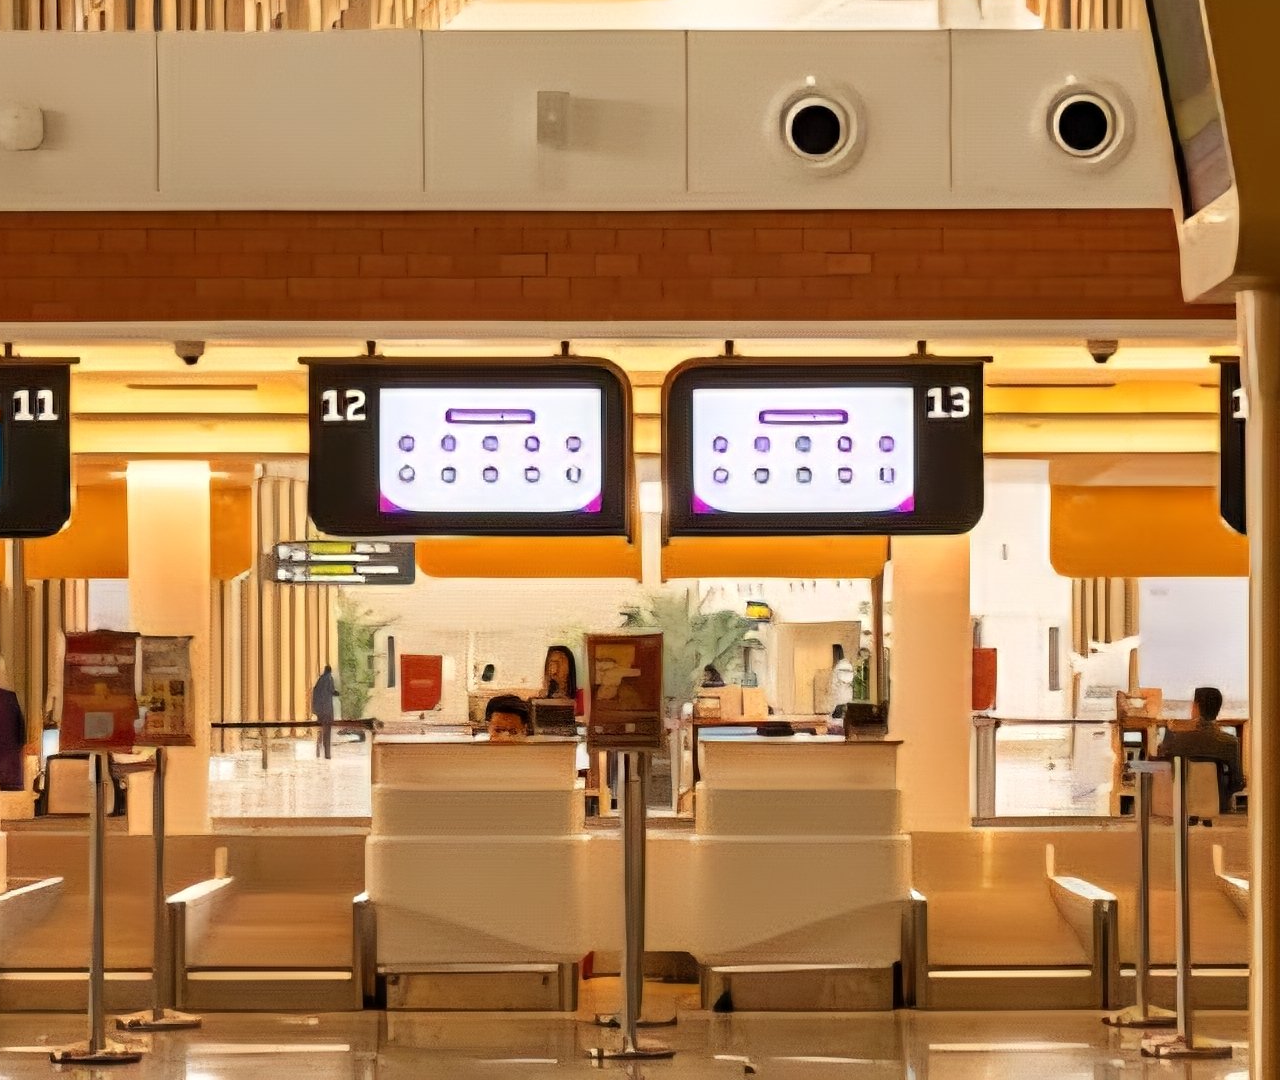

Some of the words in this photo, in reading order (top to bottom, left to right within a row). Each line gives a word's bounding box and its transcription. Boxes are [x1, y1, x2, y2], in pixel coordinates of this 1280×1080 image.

[13, 389, 59, 421] 11
[322, 389, 367, 422] 12
[927, 386, 971, 419] 13
[1232, 388, 1250, 419] 1
